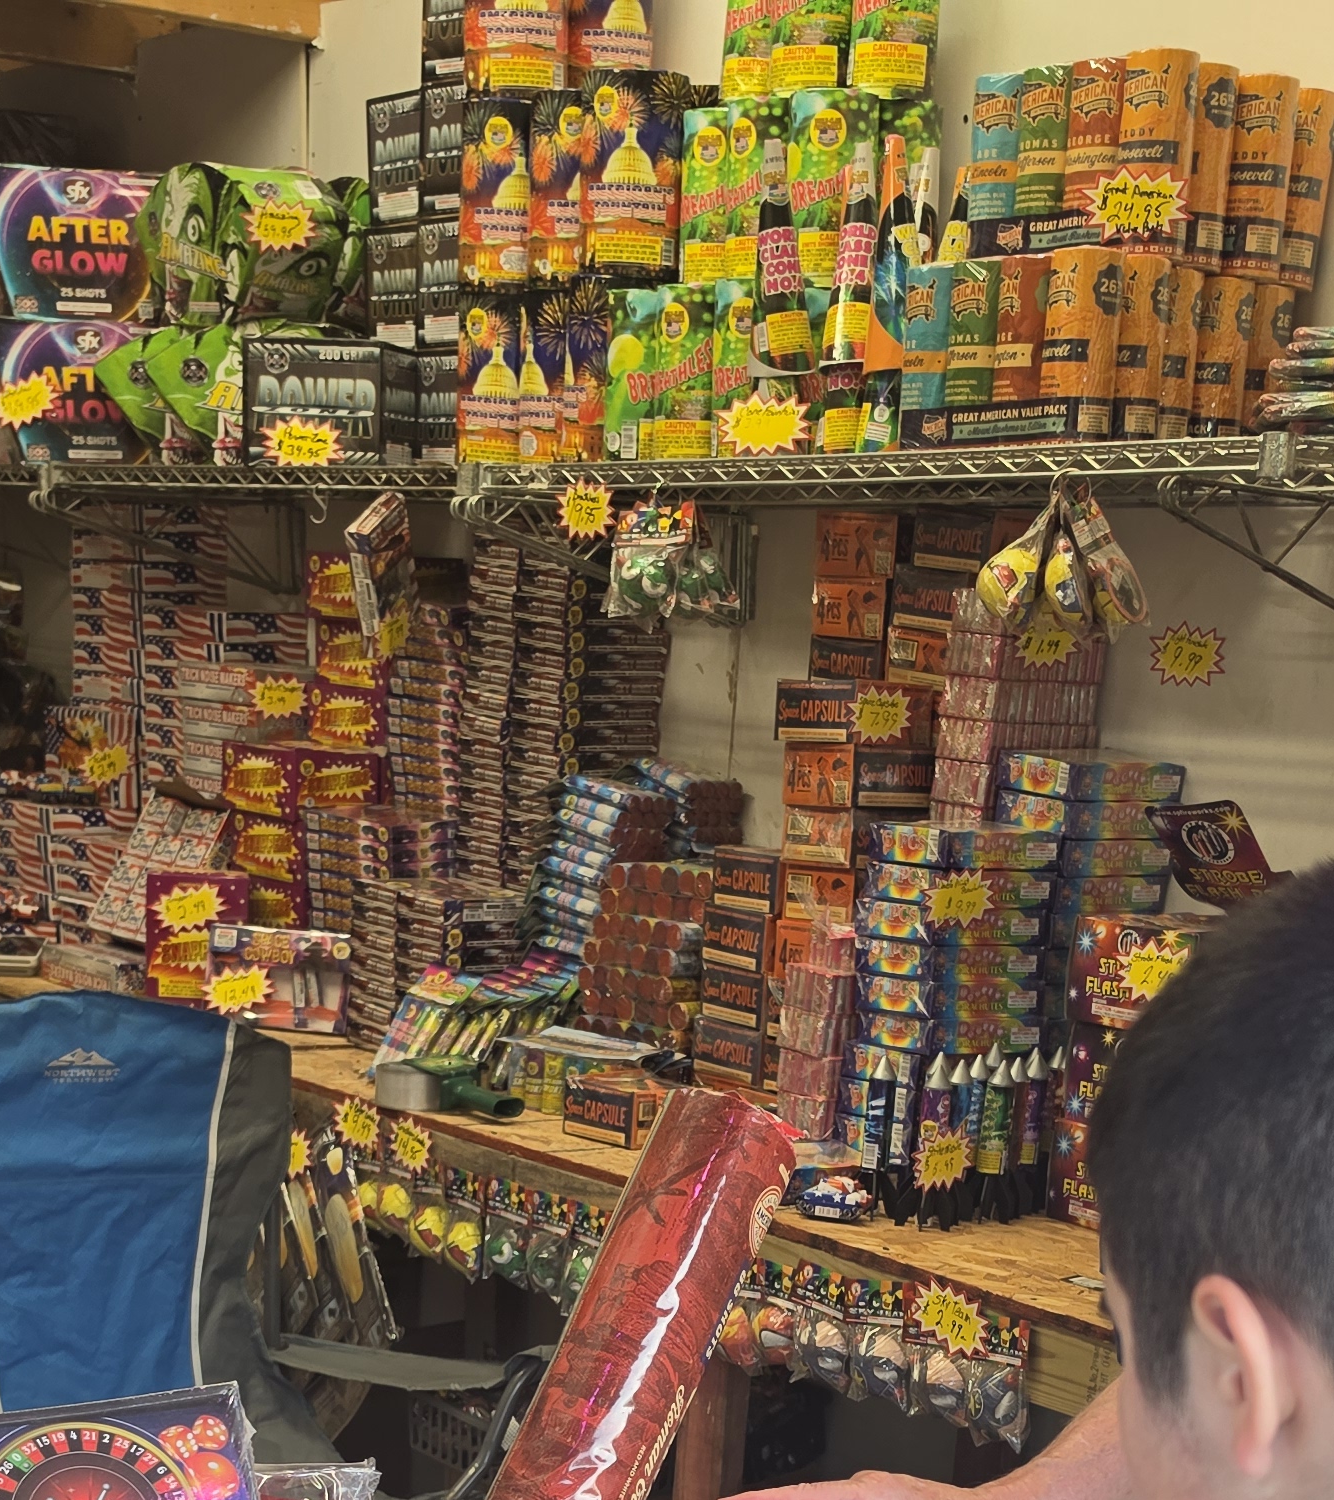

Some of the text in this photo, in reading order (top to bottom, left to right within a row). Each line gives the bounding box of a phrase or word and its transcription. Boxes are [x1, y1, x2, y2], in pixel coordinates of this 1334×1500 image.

[783, 46, 817, 56] CAUTION
[872, 44, 908, 52] CAUTION
[67, 179, 90, 202] sfx
[1108, 201, 1171, 223] 24.95
[27, 215, 130, 246] AFTER
[1029, 220, 1057, 232] GREAT
[31, 249, 128, 277] GLOW
[157, 233, 228, 280] AMAZING
[60, 287, 107, 298] 25 SHOTS
[76, 329, 100, 352] sfx
[318, 350, 340, 361] 200
[952, 404, 1067, 424] GREAT AMERICAN VALUE PACK
[665, 421, 697, 430] CAUTION
[72, 435, 118, 446] 25 SHOTS
[831, 535, 848, 557] PCS
[938, 525, 984, 553] CAPSULE
[826, 602, 841, 621] PCS
[830, 651, 874, 679] CAPSULE
[181, 667, 248, 686] TRICK NOISE MAKERS
[204, 707, 221, 720] NOISE
[222, 710, 248, 724] MAKERS
[778, 698, 848, 722] Space CAPSULE
[797, 768, 811, 789] PCS
[1025, 760, 1057, 784] PCS
[732, 869, 770, 895] CAPSULE
[1189, 866, 1264, 885] STROBE
[251, 933, 291, 948] SPACE
[721, 926, 761, 953] CAPSULE
[244, 948, 297, 965] COWBOY
[720, 981, 757, 1008] CAPSULE
[713, 1038, 752, 1067] CAPSULE
[44, 1068, 120, 1077] NORTHWEST
[584, 1098, 627, 1128] CAPSULE
[643, 1384, 687, 1475] Roman
[23, 1431, 157, 1465] 32 15 19 4 21 2 25 17 27
